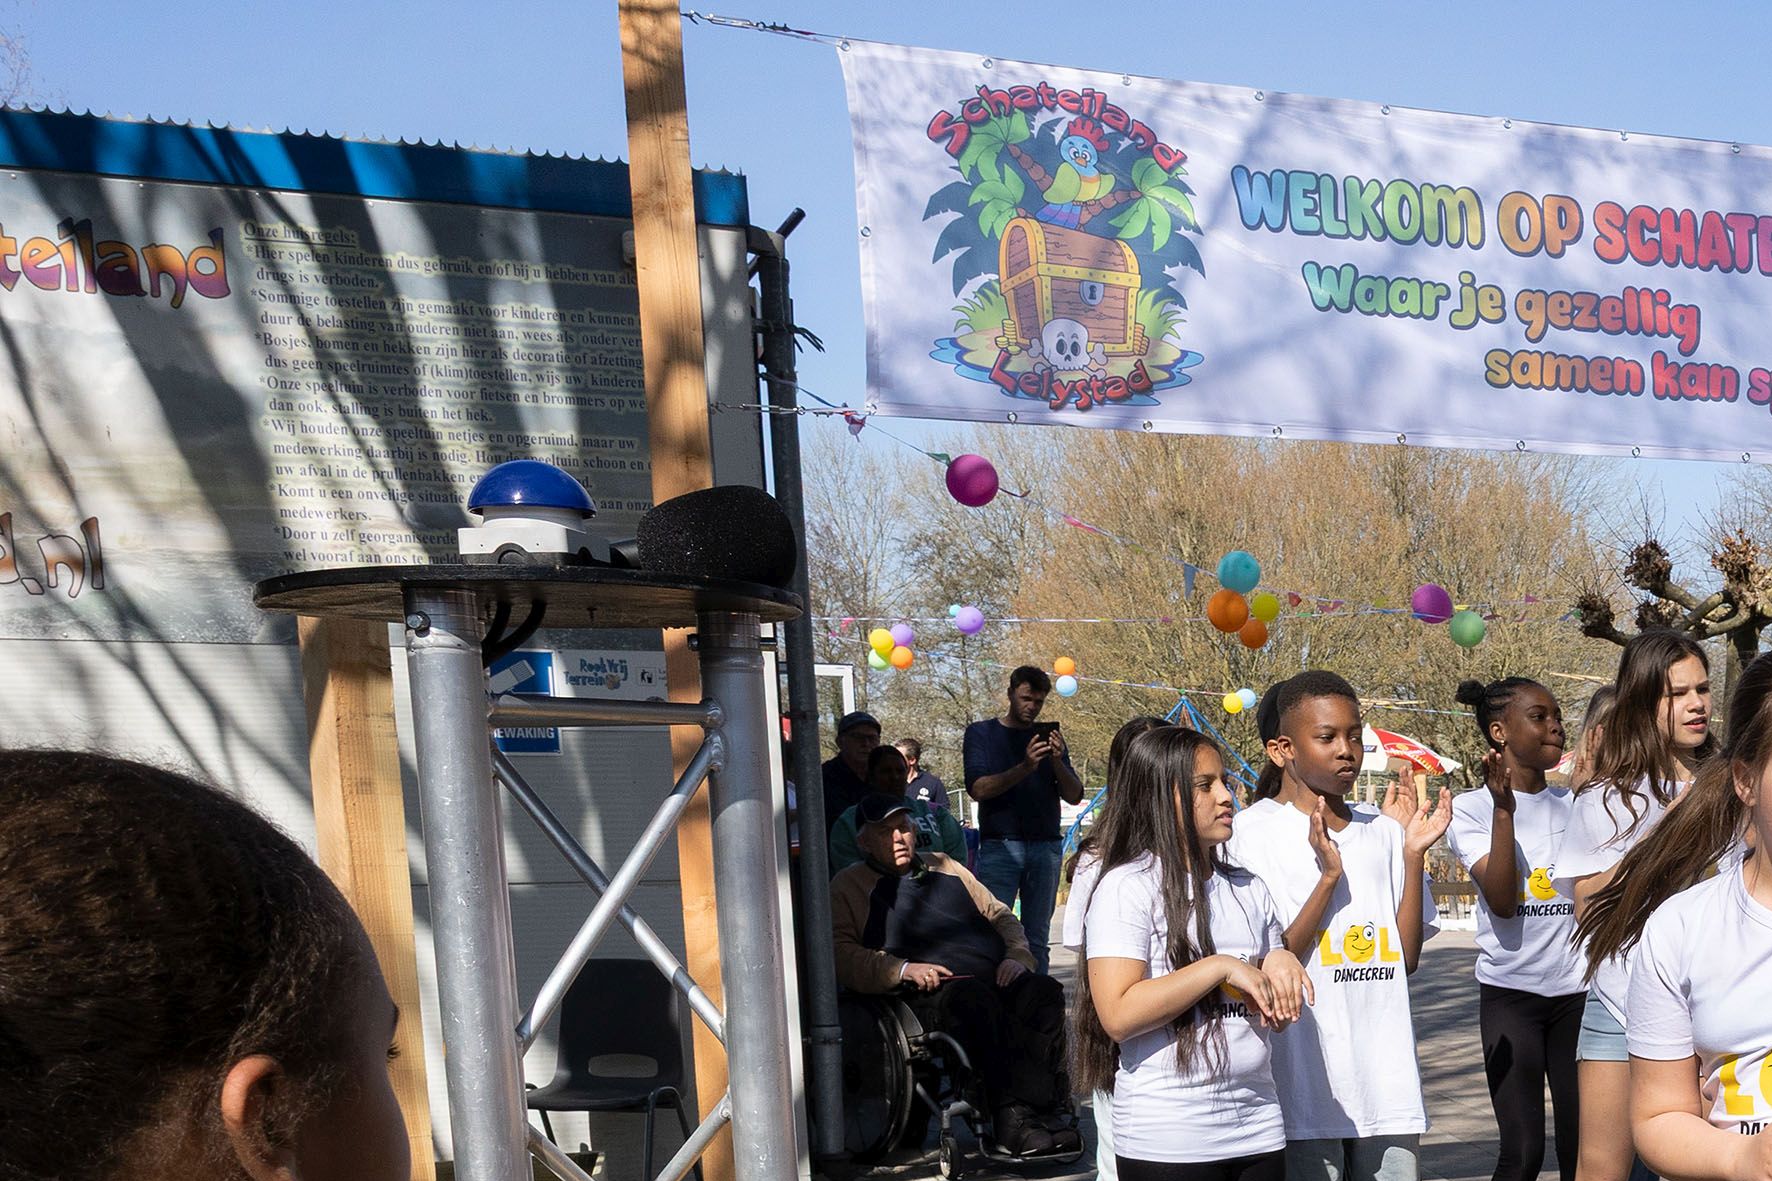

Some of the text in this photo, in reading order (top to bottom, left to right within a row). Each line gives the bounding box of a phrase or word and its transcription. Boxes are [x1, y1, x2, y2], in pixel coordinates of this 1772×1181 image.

[927, 81, 1187, 172] Schateiland
[1231, 165, 1485, 249] WELKOM
[1498, 192, 1583, 258] OP
[244, 222, 356, 243] Onze huisregels:
[257, 268, 378, 288] drugs is verboden.
[289, 251, 330, 264] spelen
[335, 252, 392, 268] kinderen
[398, 257, 419, 269] dus
[424, 259, 473, 274] gebruik
[478, 264, 510, 276] en/of
[513, 265, 529, 279] bij
[533, 269, 540, 278] u
[545, 269, 588, 282] hebben
[593, 274, 615, 283] van
[325, 294, 386, 310] toestellen
[392, 300, 413, 316] zijn
[418, 302, 475, 316] gemaakt
[478, 307, 506, 318] voor
[511, 306, 566, 322] kinderen
[571, 313, 584, 323] en
[588, 312, 634, 326] kunnen
[1302, 261, 1701, 356] Waar je gezellig
[261, 312, 292, 326] duur
[297, 313, 311, 327] de
[316, 315, 374, 334] belasting
[380, 323, 405, 333] van
[407, 321, 460, 335] ouderen
[464, 325, 486, 337] niet
[523, 333, 552, 342] wees
[557, 330, 574, 343] als
[583, 333, 617, 346] ouder
[316, 336, 359, 351] bomen
[364, 341, 378, 351] en
[383, 339, 431, 354] hekken
[435, 344, 458, 359] zijn
[463, 346, 485, 358] hier
[491, 348, 509, 360] als
[513, 349, 571, 364] decoratie
[575, 354, 587, 364] of
[265, 355, 287, 368] dus
[293, 359, 322, 372] geen
[328, 360, 409, 377] speelruimtes
[414, 365, 427, 376] of
[536, 370, 560, 386] wijs
[591, 375, 645, 388] kinderen
[989, 350, 1151, 410] Lelystad
[1484, 348, 1645, 396] samen
[1652, 350, 1739, 402] kan
[306, 379, 363, 396] speeltuin
[369, 383, 378, 394] is
[383, 383, 441, 397] verboden
[447, 389, 476, 400] voor
[480, 388, 520, 402] fietsen
[525, 393, 538, 402] en
[543, 392, 606, 407] brommers
[610, 400, 624, 411] op
[269, 398, 293, 411] dan
[332, 402, 379, 416] stalling
[384, 404, 393, 416] is
[398, 405, 437, 419] buiten
[443, 407, 462, 420] het
[466, 408, 492, 421] hek.
[301, 421, 348, 435] houden
[353, 428, 382, 436] onze
[386, 426, 442, 443] speeltuin
[448, 429, 484, 445] netjes
[489, 434, 502, 443] en
[583, 438, 614, 449] maar
[619, 440, 635, 449] uw
[273, 443, 362, 458] medewerking
[367, 446, 413, 462] daarbij
[418, 449, 427, 459] is
[433, 448, 471, 463] nodig.
[584, 456, 626, 470] schoon
[631, 461, 644, 470] en
[276, 467, 294, 476] uw
[300, 464, 331, 478] afval
[337, 465, 348, 478] in
[353, 467, 367, 479] de
[372, 467, 464, 483] prullenbakken
[319, 488, 326, 498] u
[331, 489, 352, 499] een
[358, 488, 414, 503] onveilige
[418, 492, 464, 504] situatie
[601, 500, 623, 510] aan
[280, 507, 372, 521] medewerkers.
[321, 530, 328, 540] u
[333, 528, 355, 541] zelf
[359, 531, 456, 545] georganiseerde
[285, 549, 306, 561] wel
[311, 550, 354, 563] vooraf
[358, 553, 381, 564] aan
[386, 555, 407, 564] ons
[412, 555, 423, 564] te
[493, 727, 555, 740] EWAKING
[1516, 903, 1575, 917] DANCECREW
[1334, 967, 1395, 983] DANCECREW
